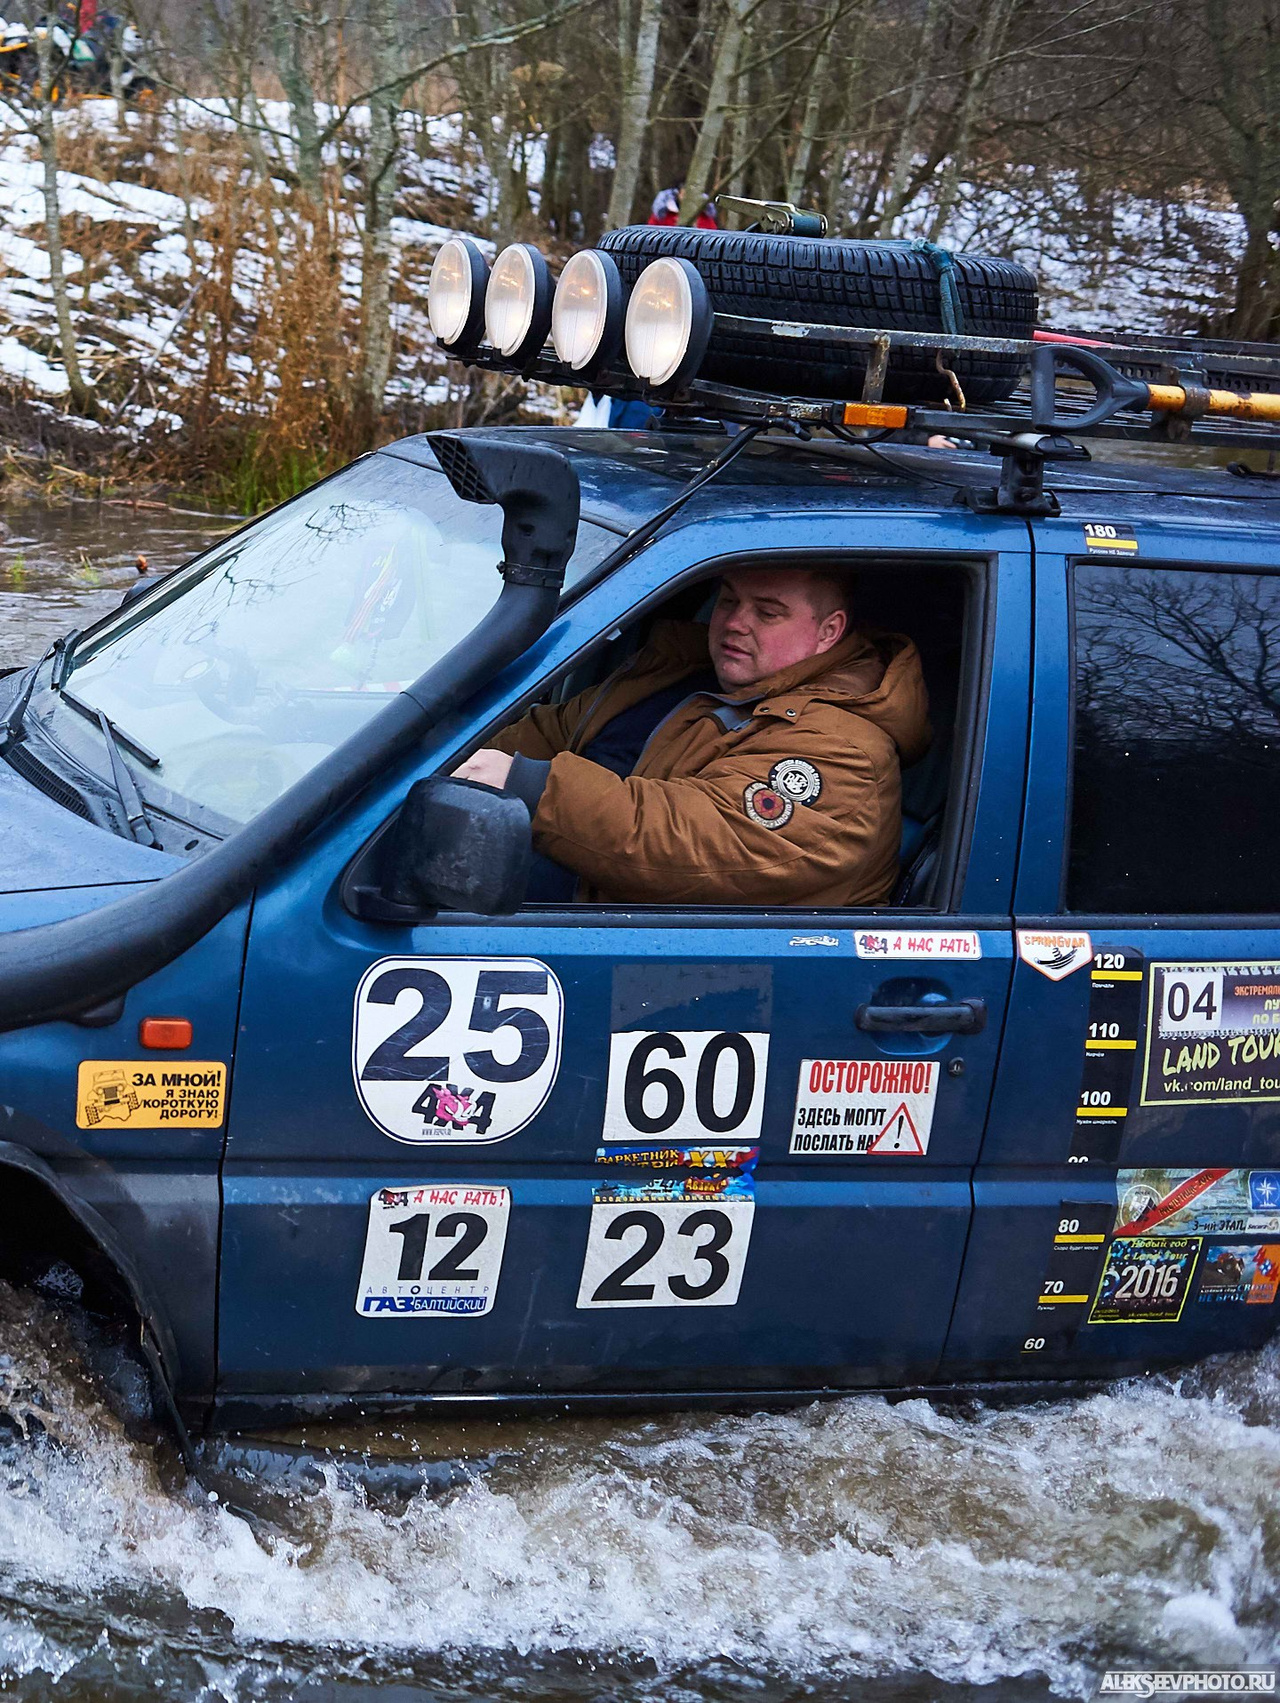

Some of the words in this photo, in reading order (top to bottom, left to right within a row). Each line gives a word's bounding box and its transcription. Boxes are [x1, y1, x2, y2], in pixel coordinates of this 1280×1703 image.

[1084, 523, 1117, 538] 180
[893, 936, 902, 951] А
[908, 937, 933, 953] НАС
[939, 934, 976, 954] РАТЬ!
[1024, 935, 1086, 948] SPRINGVAR
[1094, 953, 1125, 969] 120
[1167, 981, 1217, 1022] 04
[361, 968, 550, 1083] 25
[1252, 1013, 1269, 1024] ПО
[1089, 1022, 1120, 1038] 110
[1162, 1042, 1220, 1076] LAND
[132, 1073, 156, 1087] ЗА
[161, 1070, 221, 1087] МНОЙ!
[623, 1032, 756, 1134] 60
[809, 1061, 932, 1094] ОСТОРОЖНО!
[166, 1090, 175, 1098] Я
[179, 1089, 219, 1098] ЗНАЮ
[1081, 1091, 1111, 1106] 100
[143, 1099, 219, 1108] КОРОТКУЮ
[159, 1109, 218, 1119] ДОРОГУ!
[797, 1108, 841, 1128] ЗДЕСЬ
[843, 1108, 887, 1126] МОГУТ
[794, 1134, 854, 1151] ПОСЛАТЬ
[856, 1134, 879, 1151] НА
[413, 1190, 424, 1203] А
[429, 1190, 458, 1205] НАС
[463, 1188, 505, 1207] РАТЬ!
[1058, 1219, 1080, 1233] 80
[389, 1212, 488, 1281] 12
[591, 1210, 733, 1301] 23
[1043, 1281, 1065, 1294] 70
[1115, 1264, 1182, 1299] 2016
[366, 1286, 490, 1295] АВТОЦЕНТР
[363, 1297, 415, 1312] ГАЗ
[414, 1297, 486, 1311] БАЛТИЙСКИЙ
[1024, 1338, 1046, 1351] 60
